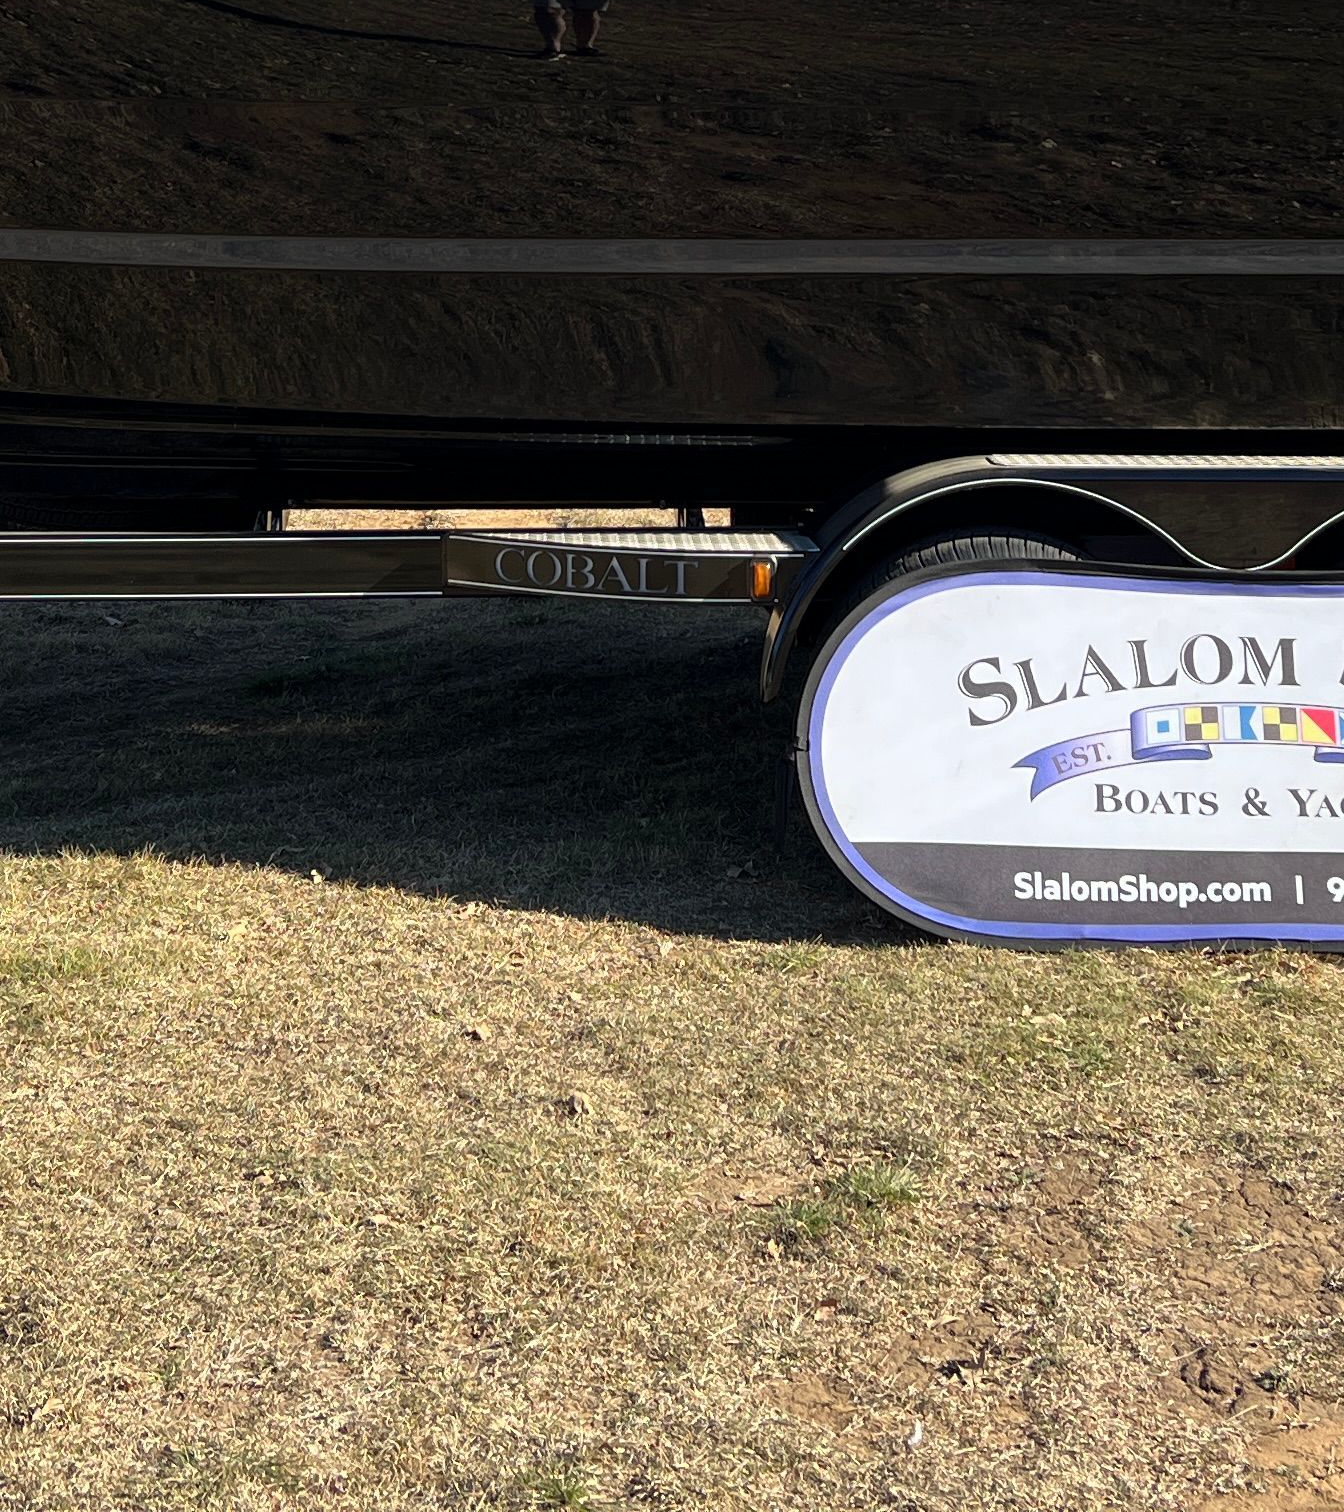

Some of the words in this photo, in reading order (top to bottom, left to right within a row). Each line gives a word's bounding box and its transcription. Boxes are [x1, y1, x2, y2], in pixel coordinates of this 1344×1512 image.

[494, 547, 699, 595] COBALT
[957, 633, 1302, 727] SLALOM
[1051, 742, 1112, 775] EST.
[1094, 783, 1219, 816] BOATS
[1241, 787, 1272, 817] &
[1013, 871, 1272, 909] SlalomShop.com
